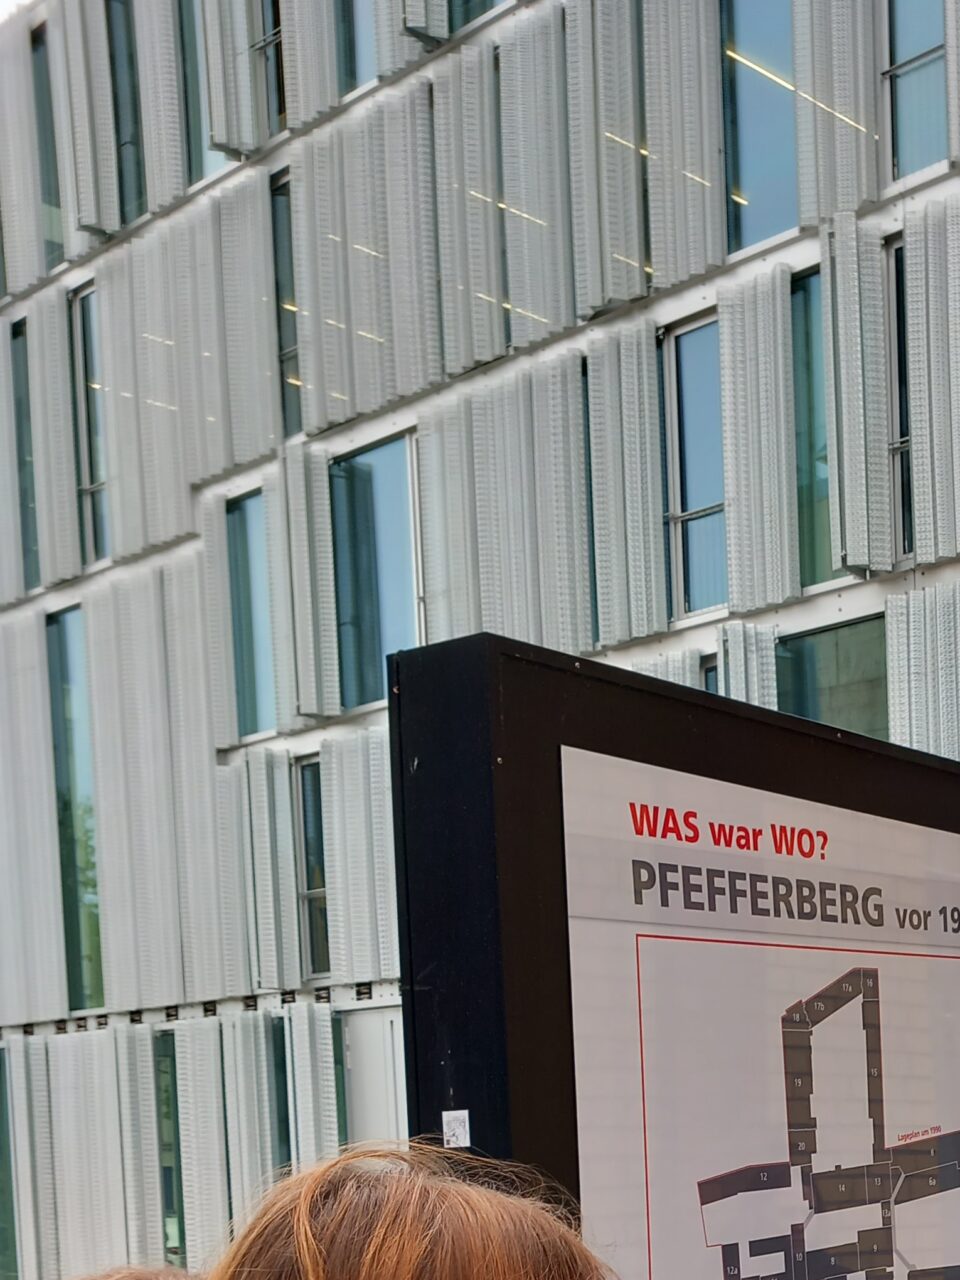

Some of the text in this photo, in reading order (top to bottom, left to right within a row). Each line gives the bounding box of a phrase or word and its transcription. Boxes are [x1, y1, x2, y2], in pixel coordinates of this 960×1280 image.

[629, 802, 828, 860] WAS war WO?
[632, 859, 884, 927] PFEFFERBERG
[896, 907, 931, 931] vor
[867, 979, 873, 987] 16
[843, 984, 852, 992] 17a
[814, 1002, 824, 1010] 17b
[793, 1013, 799, 1021] 18
[795, 1079, 801, 1087] 19
[898, 1130, 920, 1142] Lageplan
[798, 1142, 805, 1150] 20
[929, 1177, 936, 1185] 6a
[873, 1244, 878, 1252] 9
